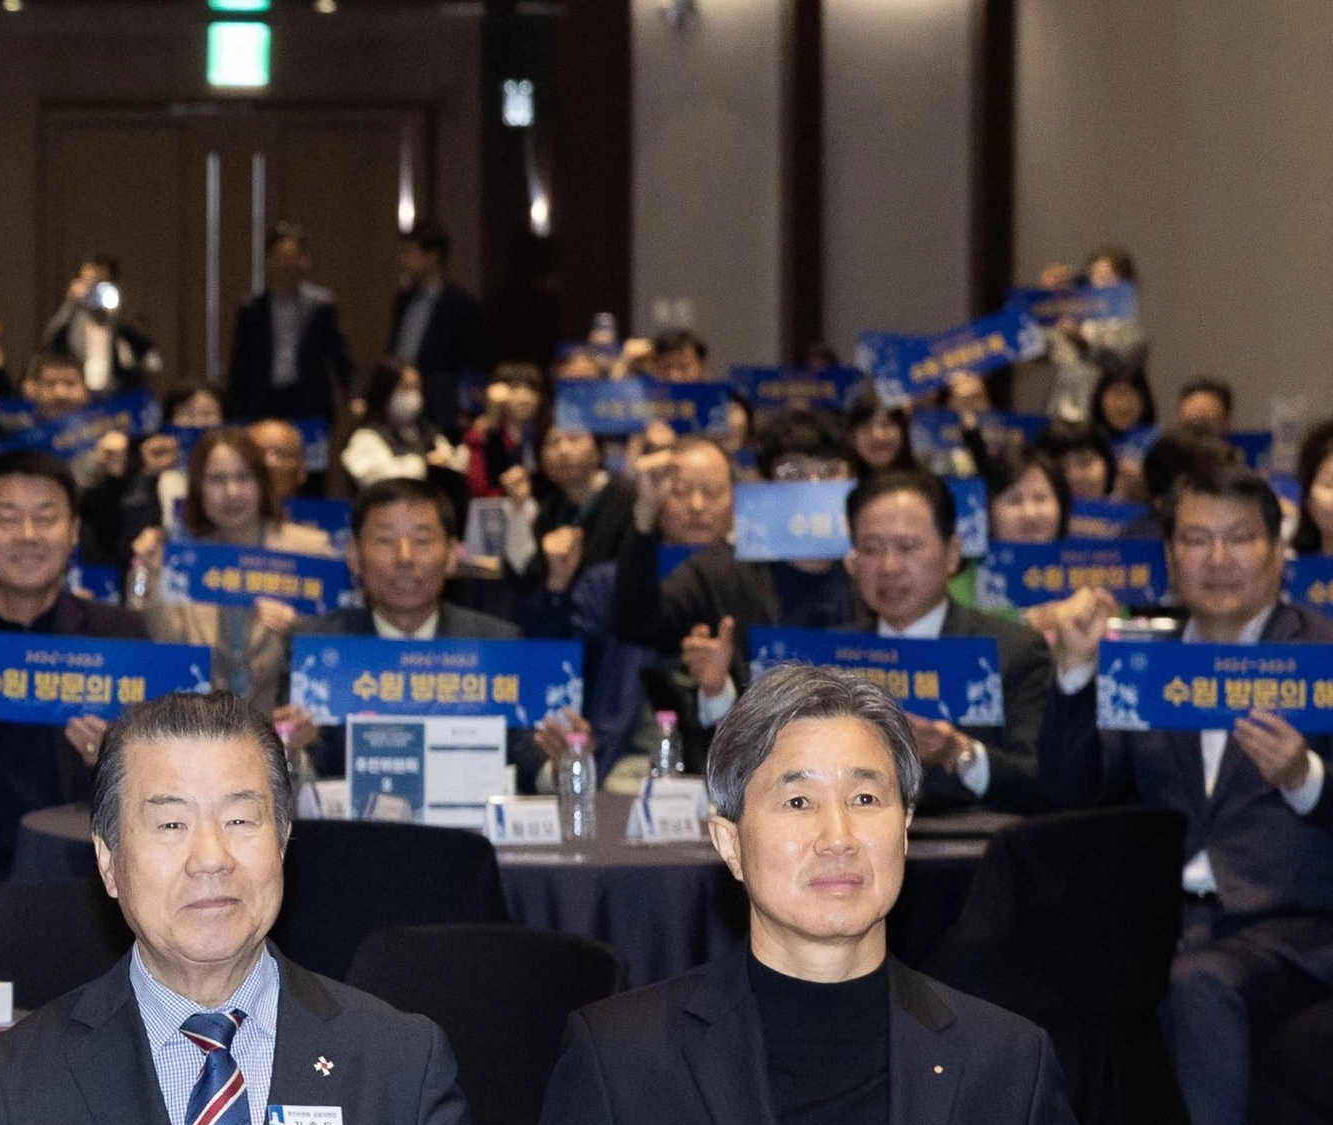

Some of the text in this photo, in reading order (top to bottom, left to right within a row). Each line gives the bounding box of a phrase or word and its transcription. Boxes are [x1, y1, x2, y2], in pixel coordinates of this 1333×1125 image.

[34, 670, 113, 705] 방문의
[352, 670, 405, 703] 수원
[409, 671, 488, 704] 방문의
[1163, 676, 1218, 709] 수원
[1224, 677, 1308, 711] 방문의
